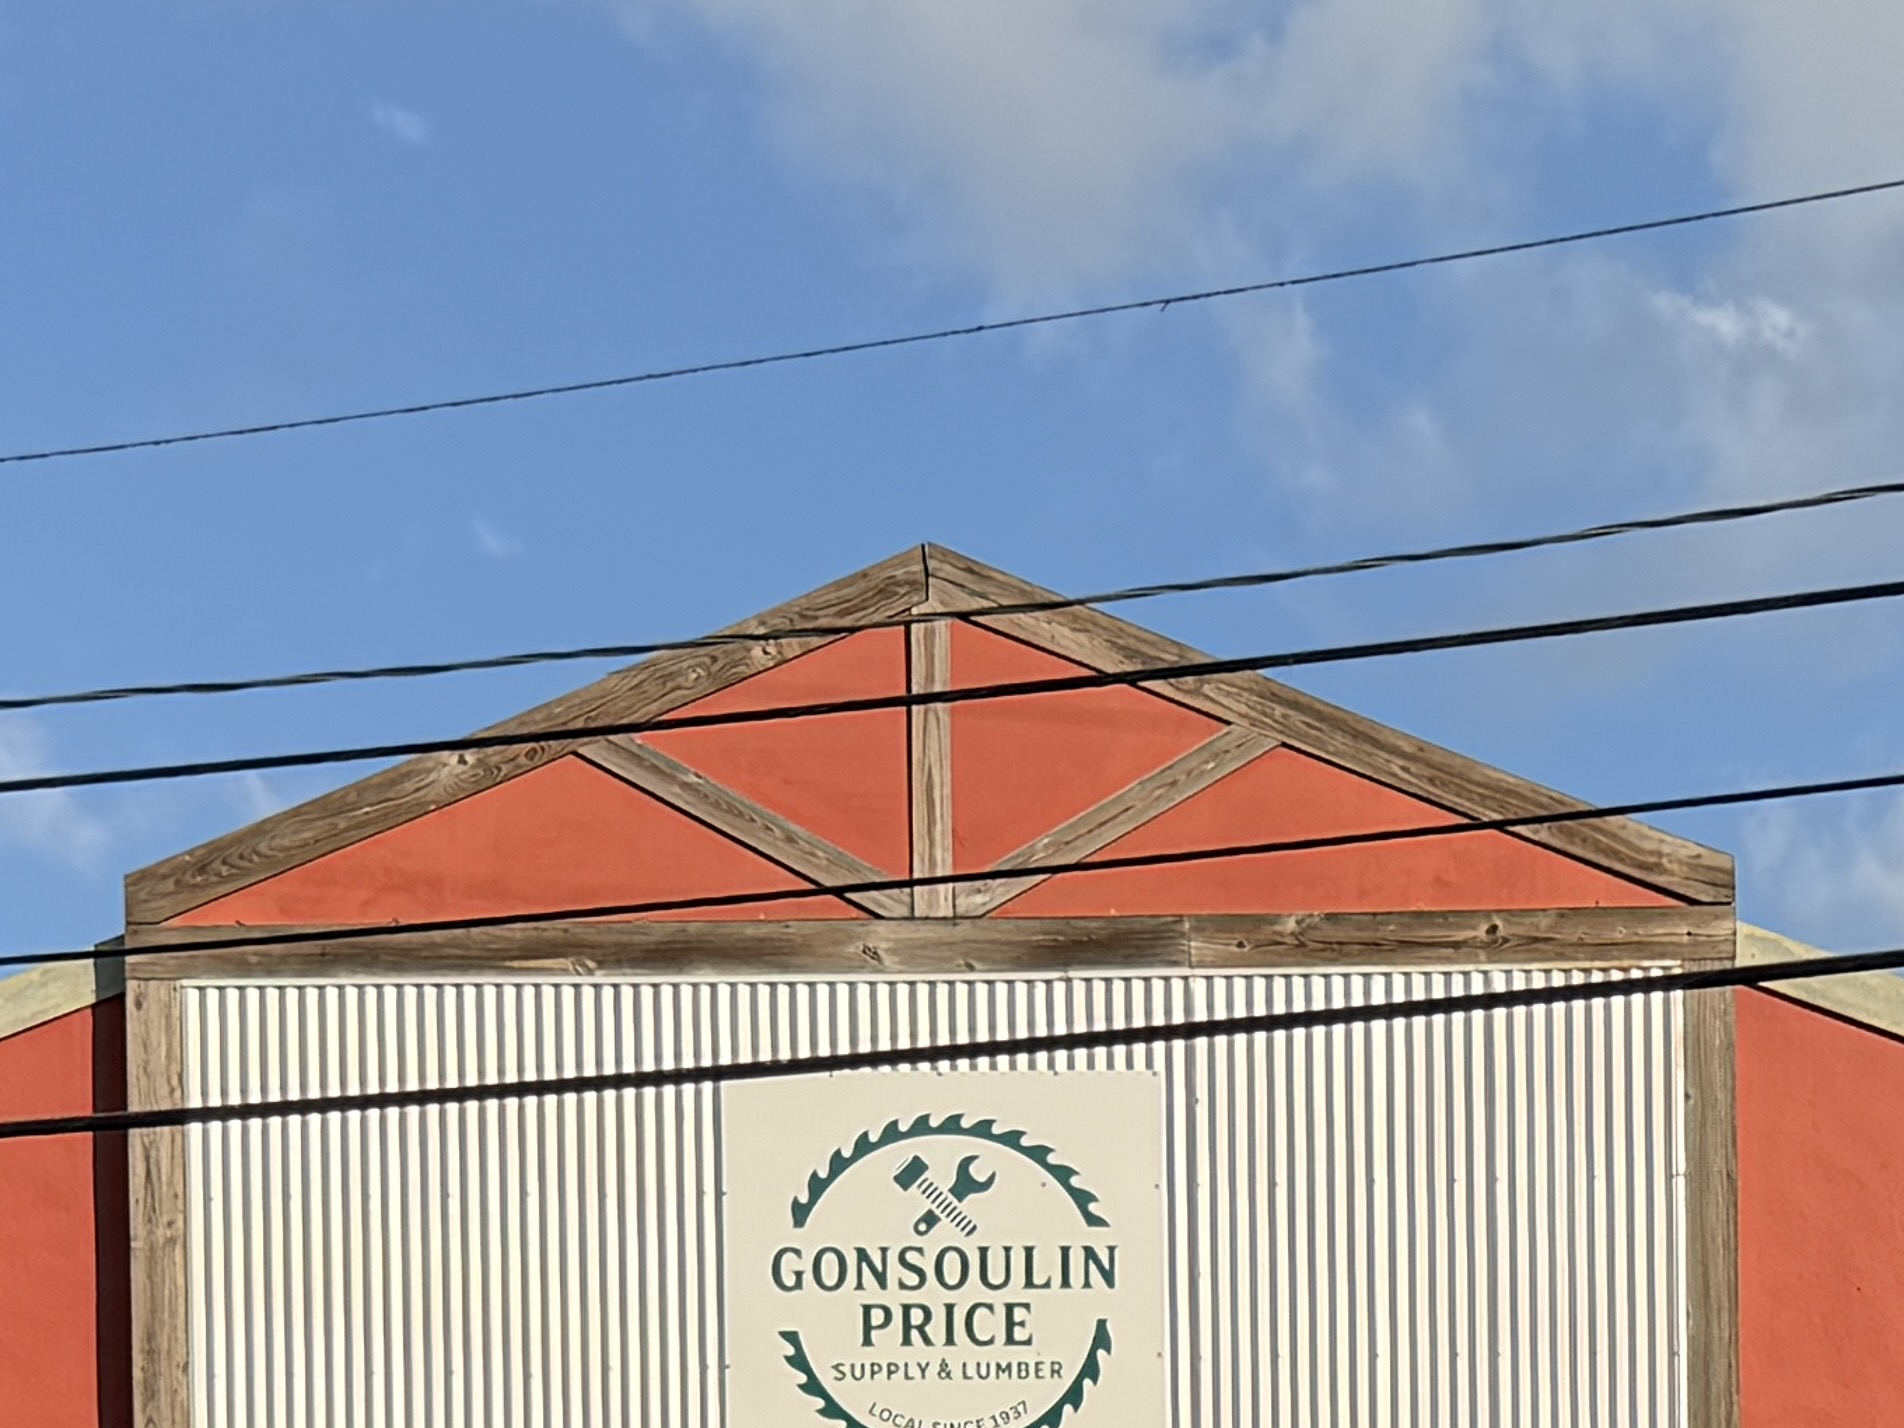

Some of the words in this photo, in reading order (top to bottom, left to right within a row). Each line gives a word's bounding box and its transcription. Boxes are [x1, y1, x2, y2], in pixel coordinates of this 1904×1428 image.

[771, 1244, 1118, 1292] GONSOULIN
[860, 1302, 1034, 1348] PRICE
[831, 1360, 929, 1382] SUPPLY
[937, 1358, 954, 1381] &
[962, 1359, 1064, 1381] LUMBER
